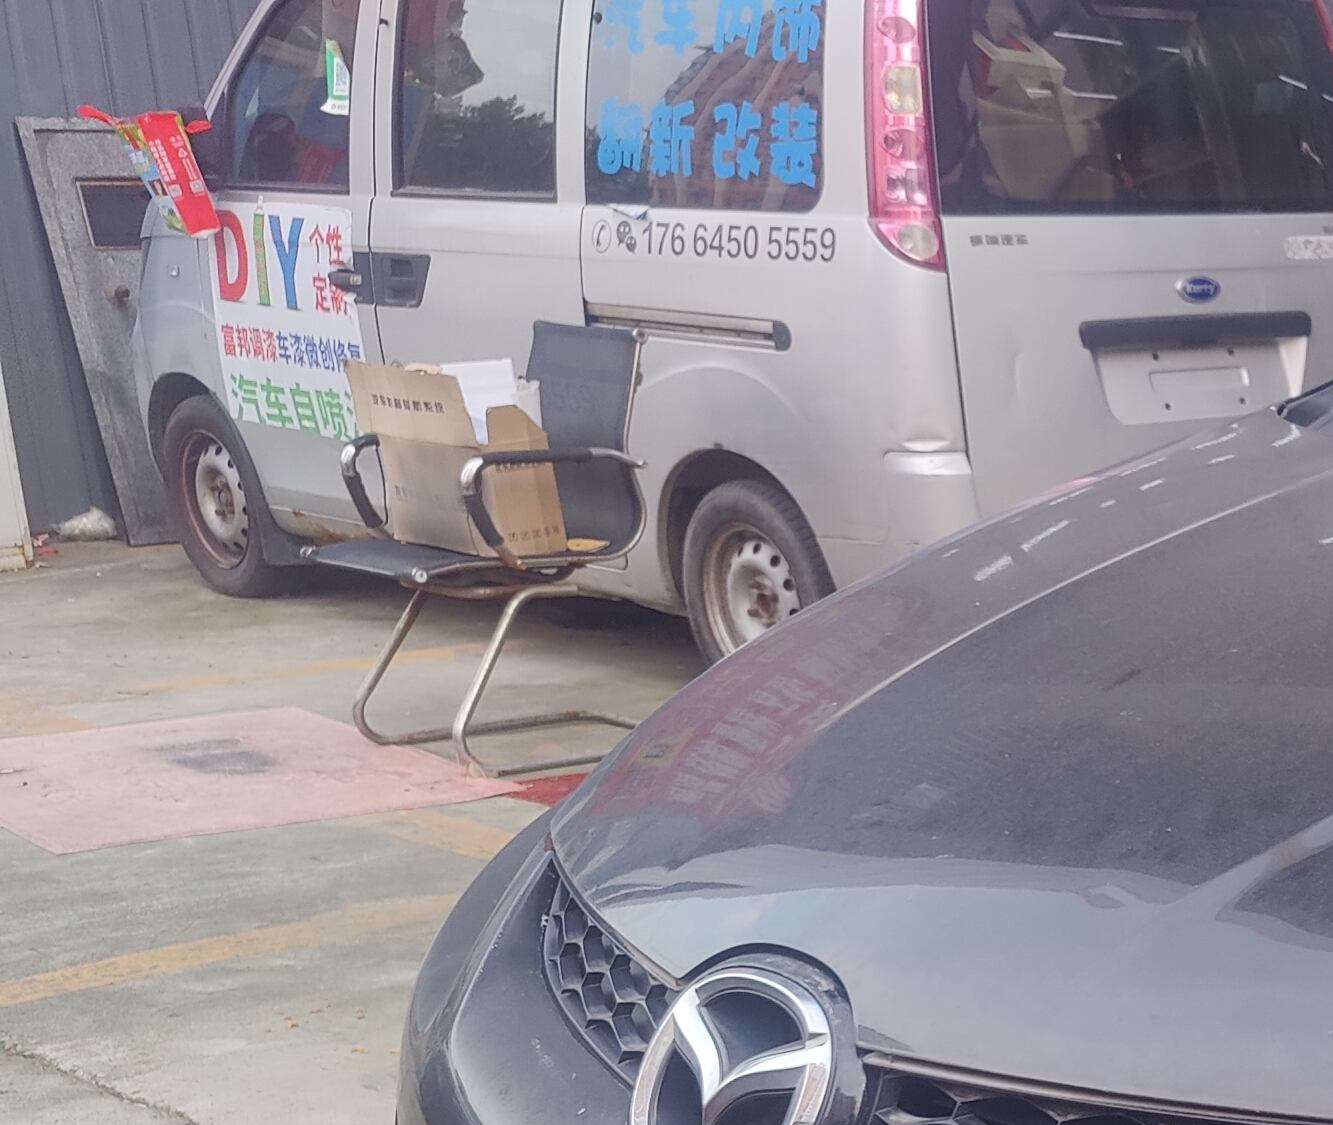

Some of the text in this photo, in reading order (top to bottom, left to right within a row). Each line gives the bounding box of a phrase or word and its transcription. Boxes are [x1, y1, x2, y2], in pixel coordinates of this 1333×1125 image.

[597, 96, 818, 188] 翻新改装
[214, 208, 305, 310] DIY
[308, 223, 343, 266] 个性
[642, 221, 836, 262] 176 6450 5559
[230, 372, 359, 440] 汽车自喷
